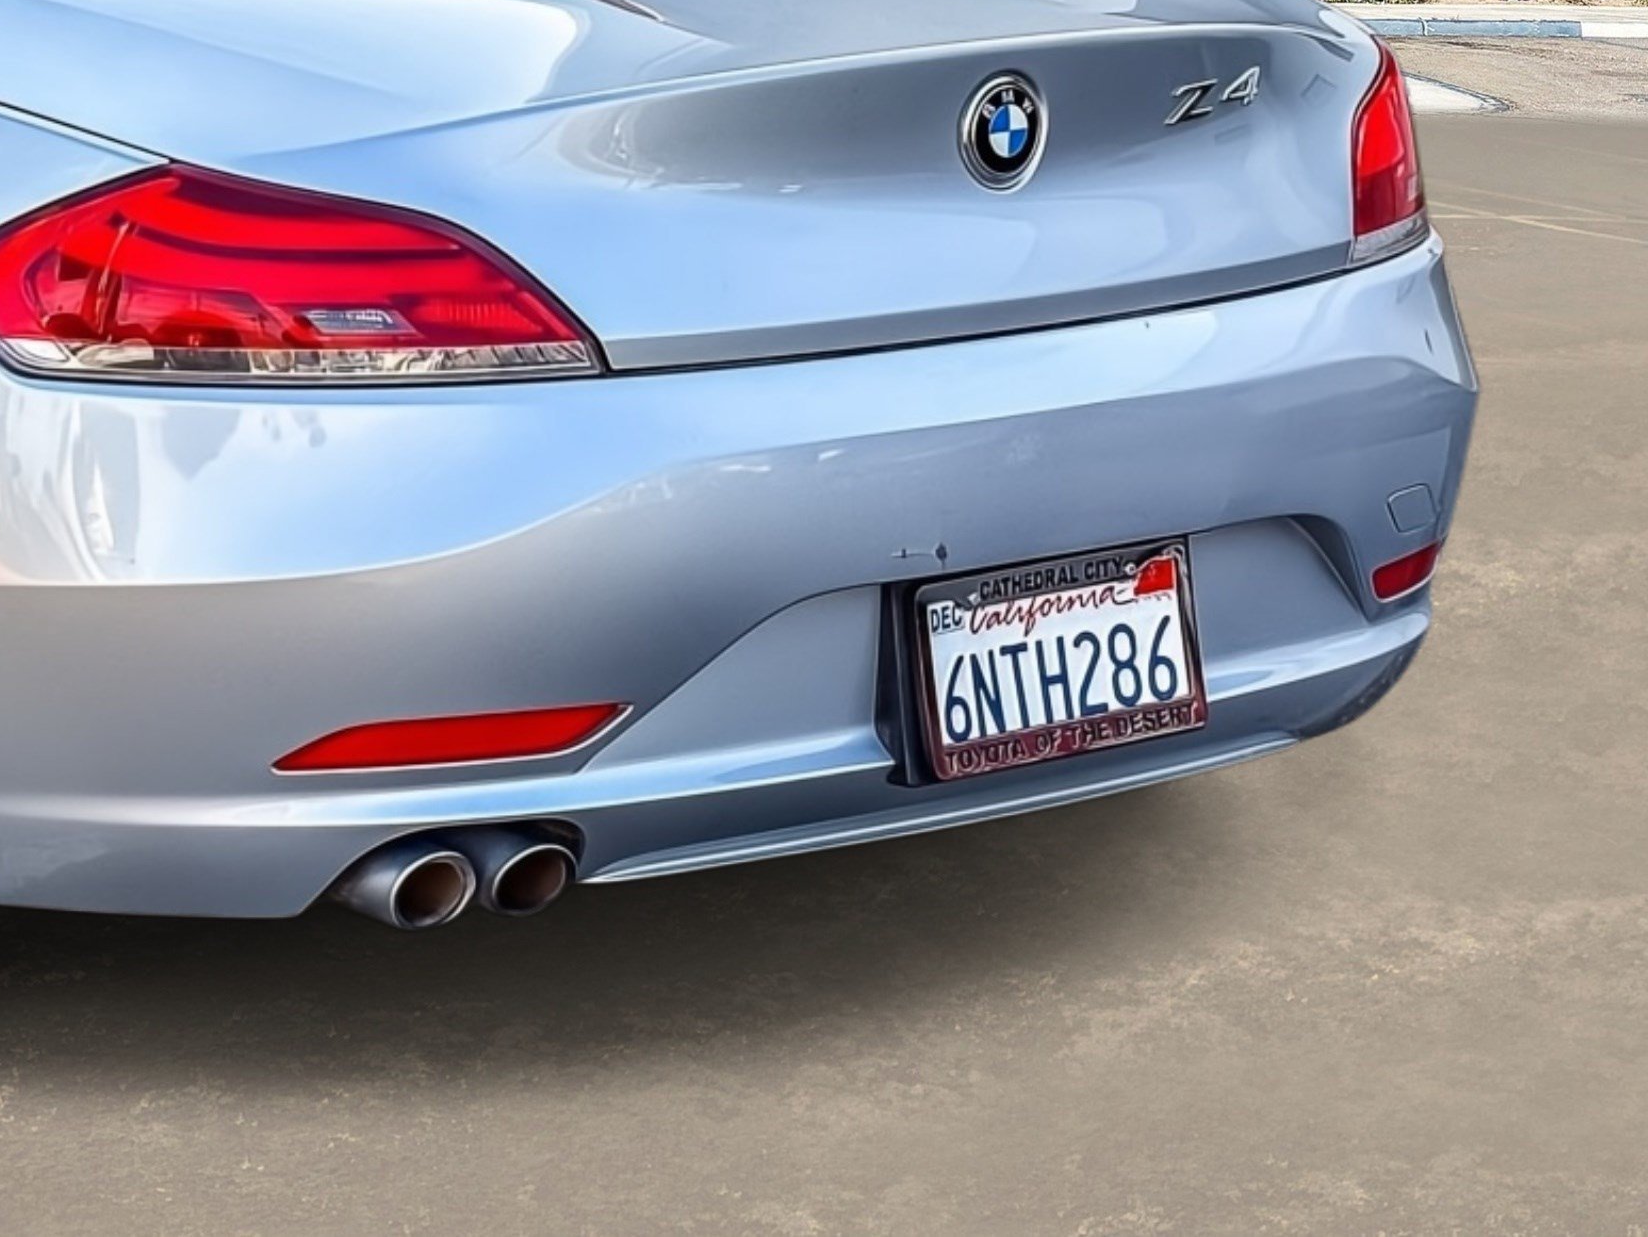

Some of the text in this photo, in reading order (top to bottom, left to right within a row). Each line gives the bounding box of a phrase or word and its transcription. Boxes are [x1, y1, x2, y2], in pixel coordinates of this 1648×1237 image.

[1163, 65, 1261, 126] Z4
[979, 556, 1125, 600] CATHEDRAL CITY
[931, 605, 964, 633] DEC
[968, 584, 1132, 637] California
[944, 614, 1178, 743] 6NTH286
[944, 702, 1200, 774] TOYOTA OF THE DESERT
